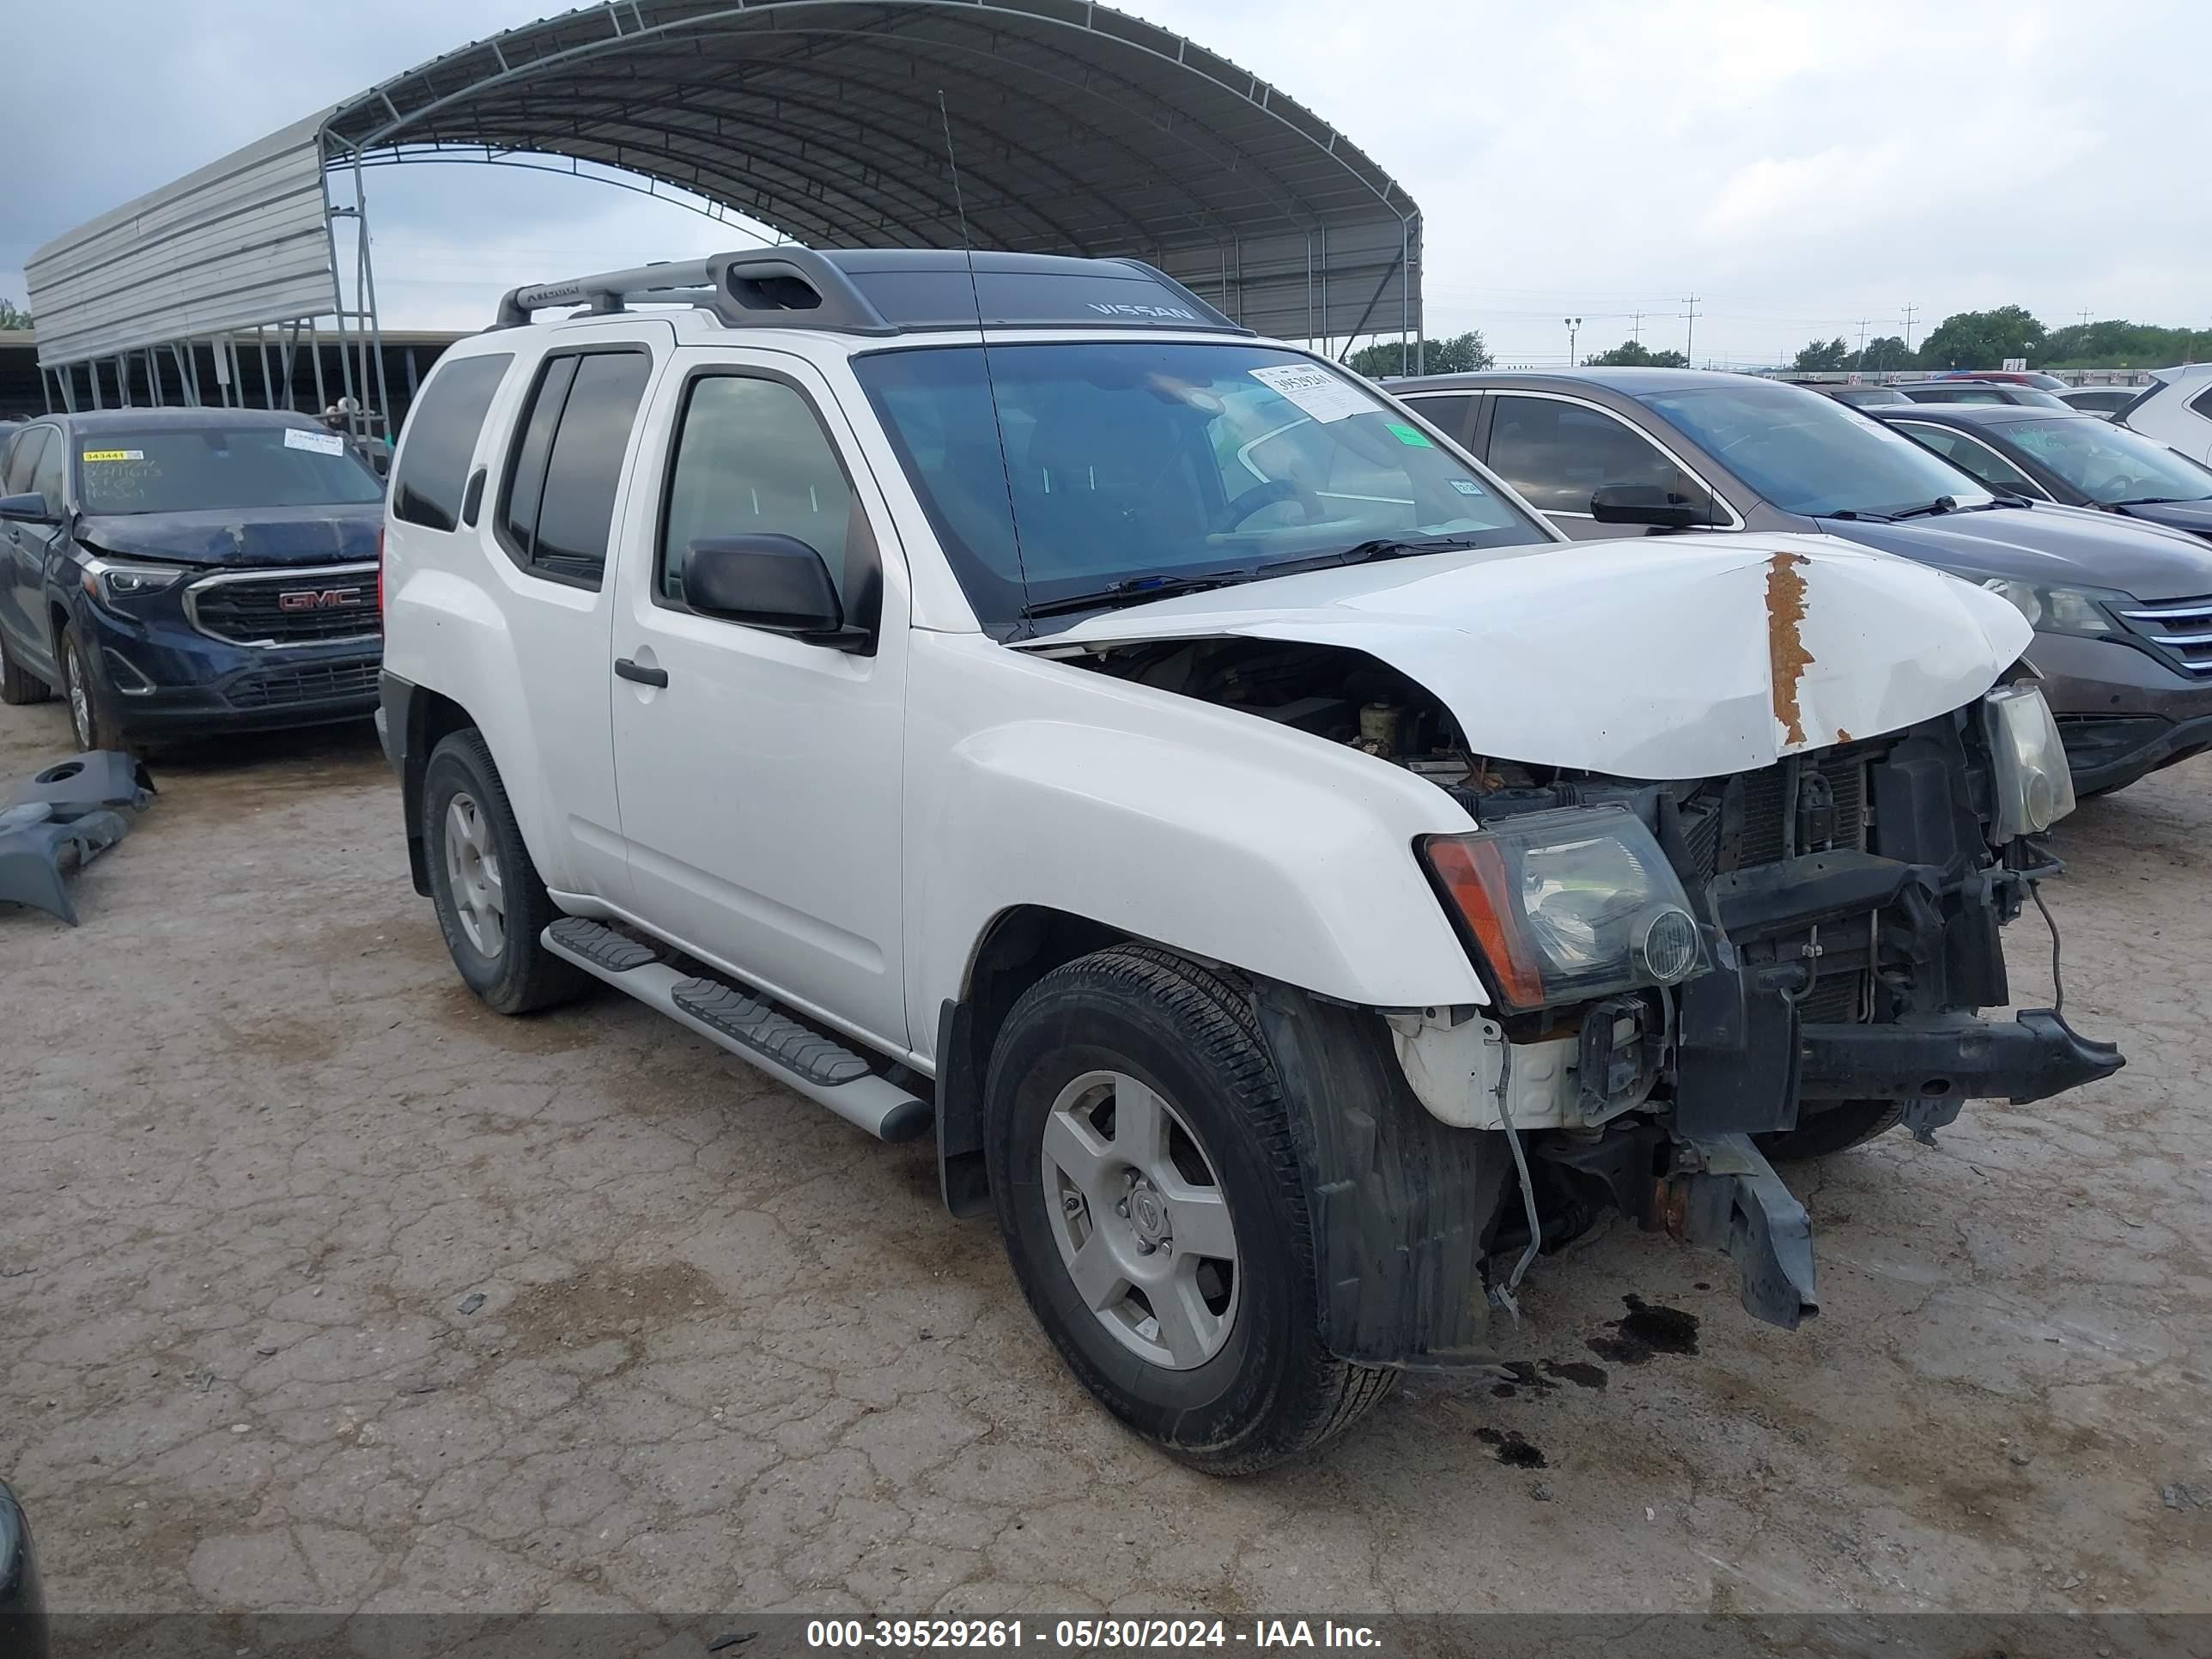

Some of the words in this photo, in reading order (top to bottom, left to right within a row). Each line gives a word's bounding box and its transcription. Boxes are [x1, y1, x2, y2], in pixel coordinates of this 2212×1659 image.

[1274, 374, 1333, 391] 39529261
[84, 452, 125, 460] 343441
[280, 587, 361, 611] GMC
